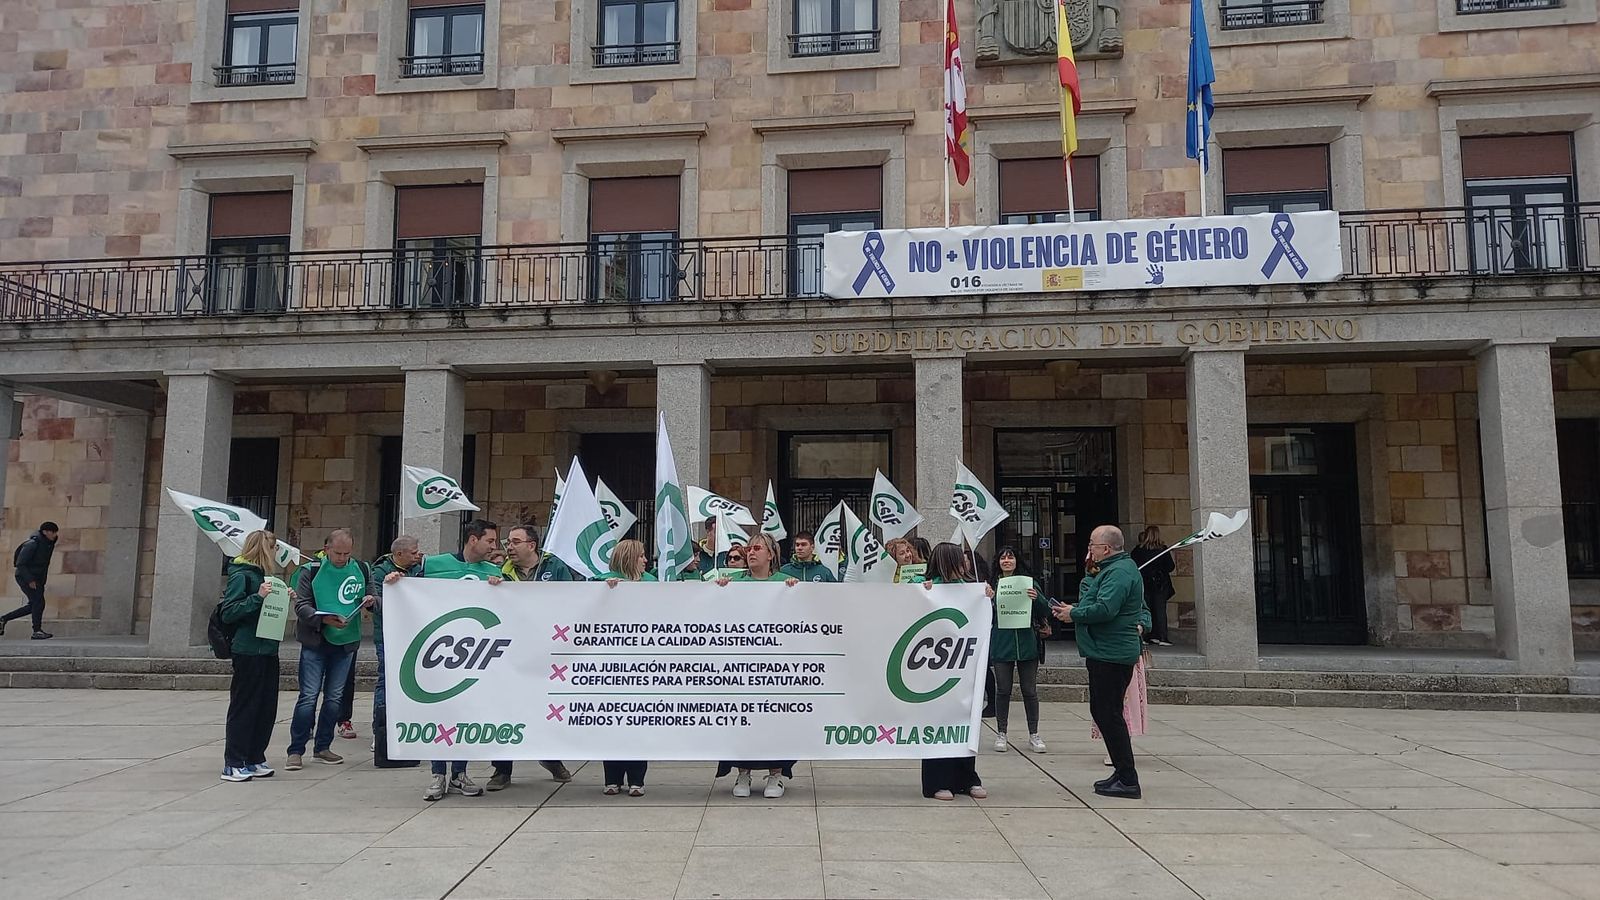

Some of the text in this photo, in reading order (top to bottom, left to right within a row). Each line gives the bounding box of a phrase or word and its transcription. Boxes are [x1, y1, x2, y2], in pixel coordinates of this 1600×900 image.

[909, 240, 942, 273] NO
[962, 234, 1098, 271] VIOLENCIA
[1106, 232, 1139, 264] DE
[1146, 223, 1249, 263] GÉNERO
[950, 275, 982, 289] 016
[812, 318, 1360, 354] SUBDELEGACION DEL GOBIERNO
[574, 621, 843, 635] UN ESTATUTO PARA TODAS LAS CATEGORÍAS QUE
[573, 636, 782, 646] GARANTICE LA CALIDAD ASISTENCIAL.
[422, 635, 512, 670] CSIF
[907, 637, 978, 670] CSIF
[572, 659, 826, 674] UNA JUBILACIÓN PARCIAL, ANTICIPADA Y POR
[571, 676, 824, 686] COEFICIENTES PARA PERSONAL ESTATUTARIO.
[569, 699, 813, 713] UNA ADECUACIÓN INMEDIATA DE TÉCNICOS
[568, 713, 613, 726] MÉDIOS
[615, 716, 624, 726] Y
[626, 716, 696, 726] SUPERIORES
[698, 716, 713, 726] AL
[741, 716, 751, 726] B.
[396, 722, 437, 744] ODO
[824, 725, 877, 744] TODO
[896, 726, 920, 744] LA
